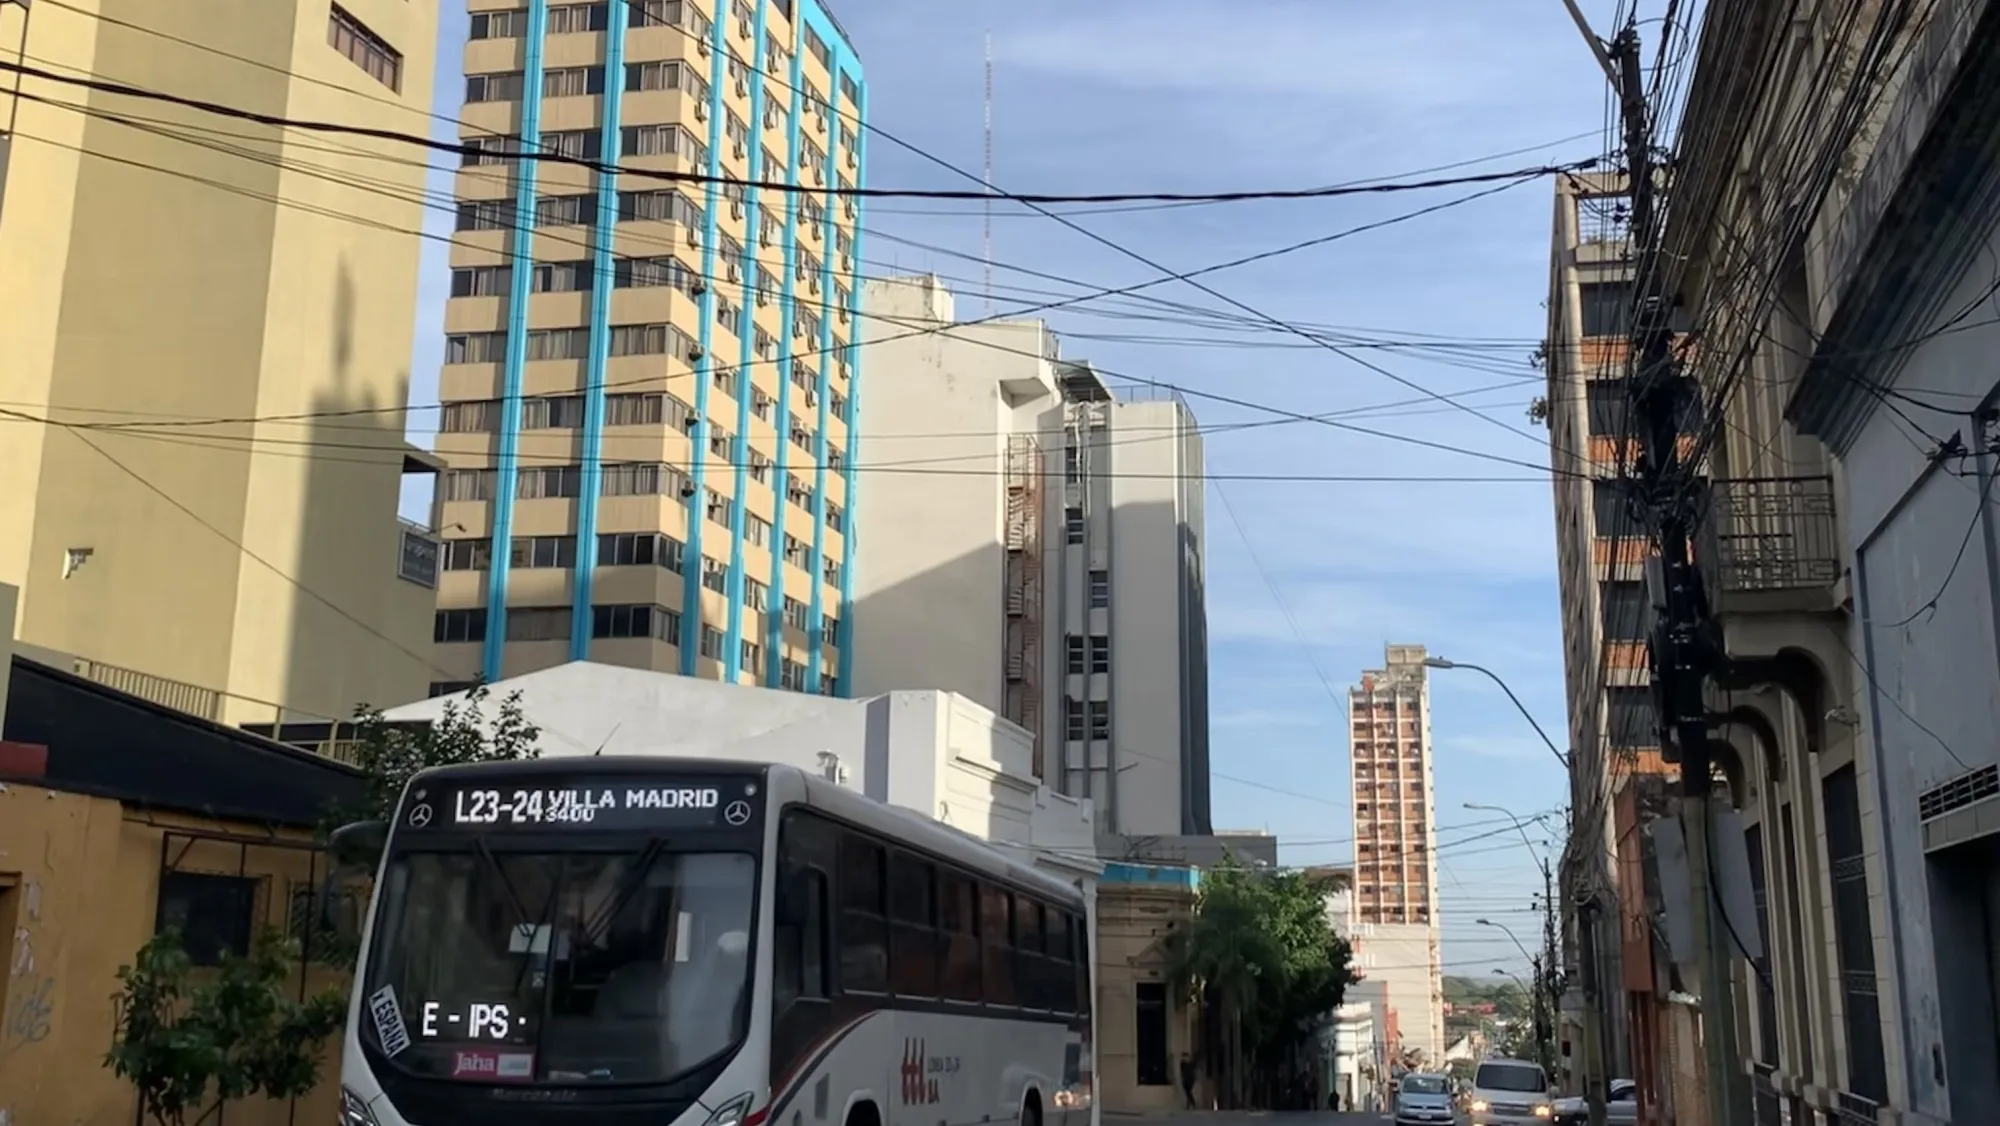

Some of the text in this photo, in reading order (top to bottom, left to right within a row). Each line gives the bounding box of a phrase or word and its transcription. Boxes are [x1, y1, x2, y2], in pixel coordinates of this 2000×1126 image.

[455, 788, 719, 823] L23-24 VILLA MADRID
[422, 1002, 440, 1036] E
[468, 1003, 509, 1039] IPS
[454, 1052, 495, 1076] Jaha
